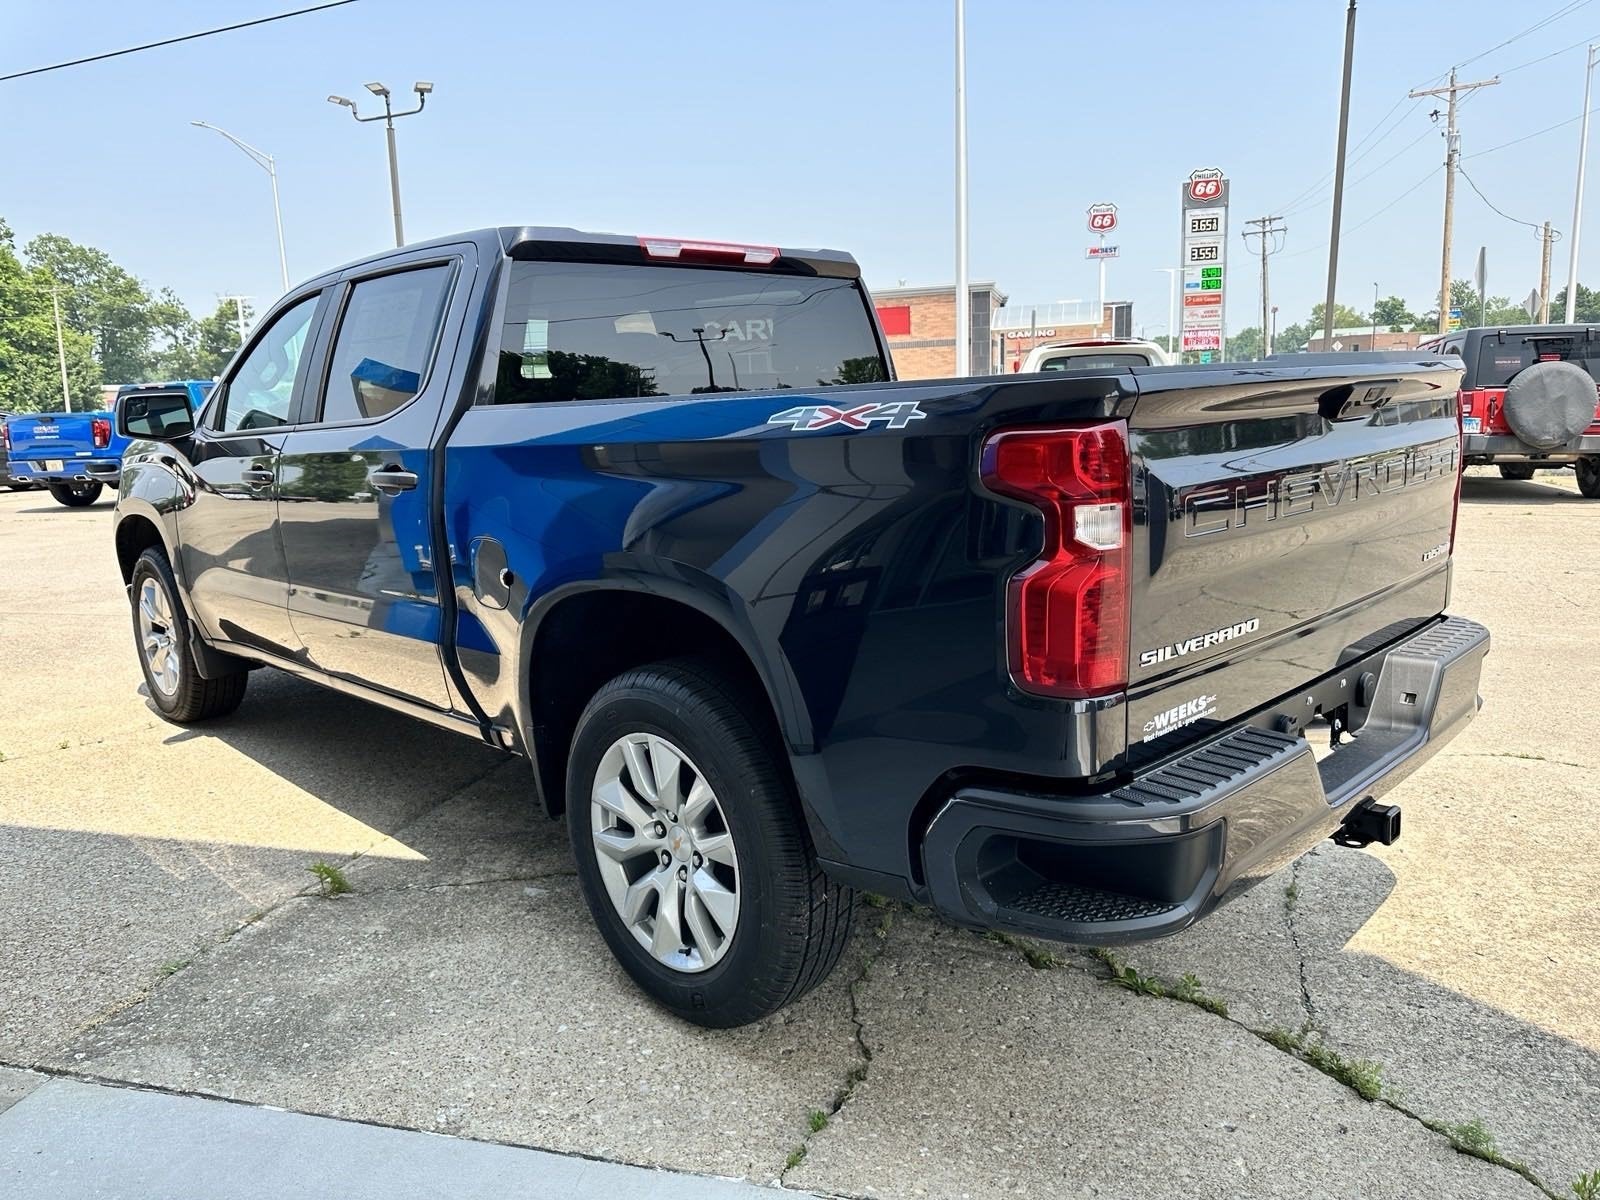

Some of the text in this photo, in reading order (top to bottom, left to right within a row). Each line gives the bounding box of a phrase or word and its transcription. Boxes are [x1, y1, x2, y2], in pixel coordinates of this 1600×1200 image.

[1194, 172, 1219, 180] PHILLIPS
[1195, 181, 1217, 195] 66
[1093, 215, 1112, 227] 66
[1007, 330, 1056, 339] GAMING
[1184, 448, 1457, 538] CHEVROLET
[1139, 617, 1260, 667] SILVERADO
[1154, 695, 1207, 730] WEEKS
